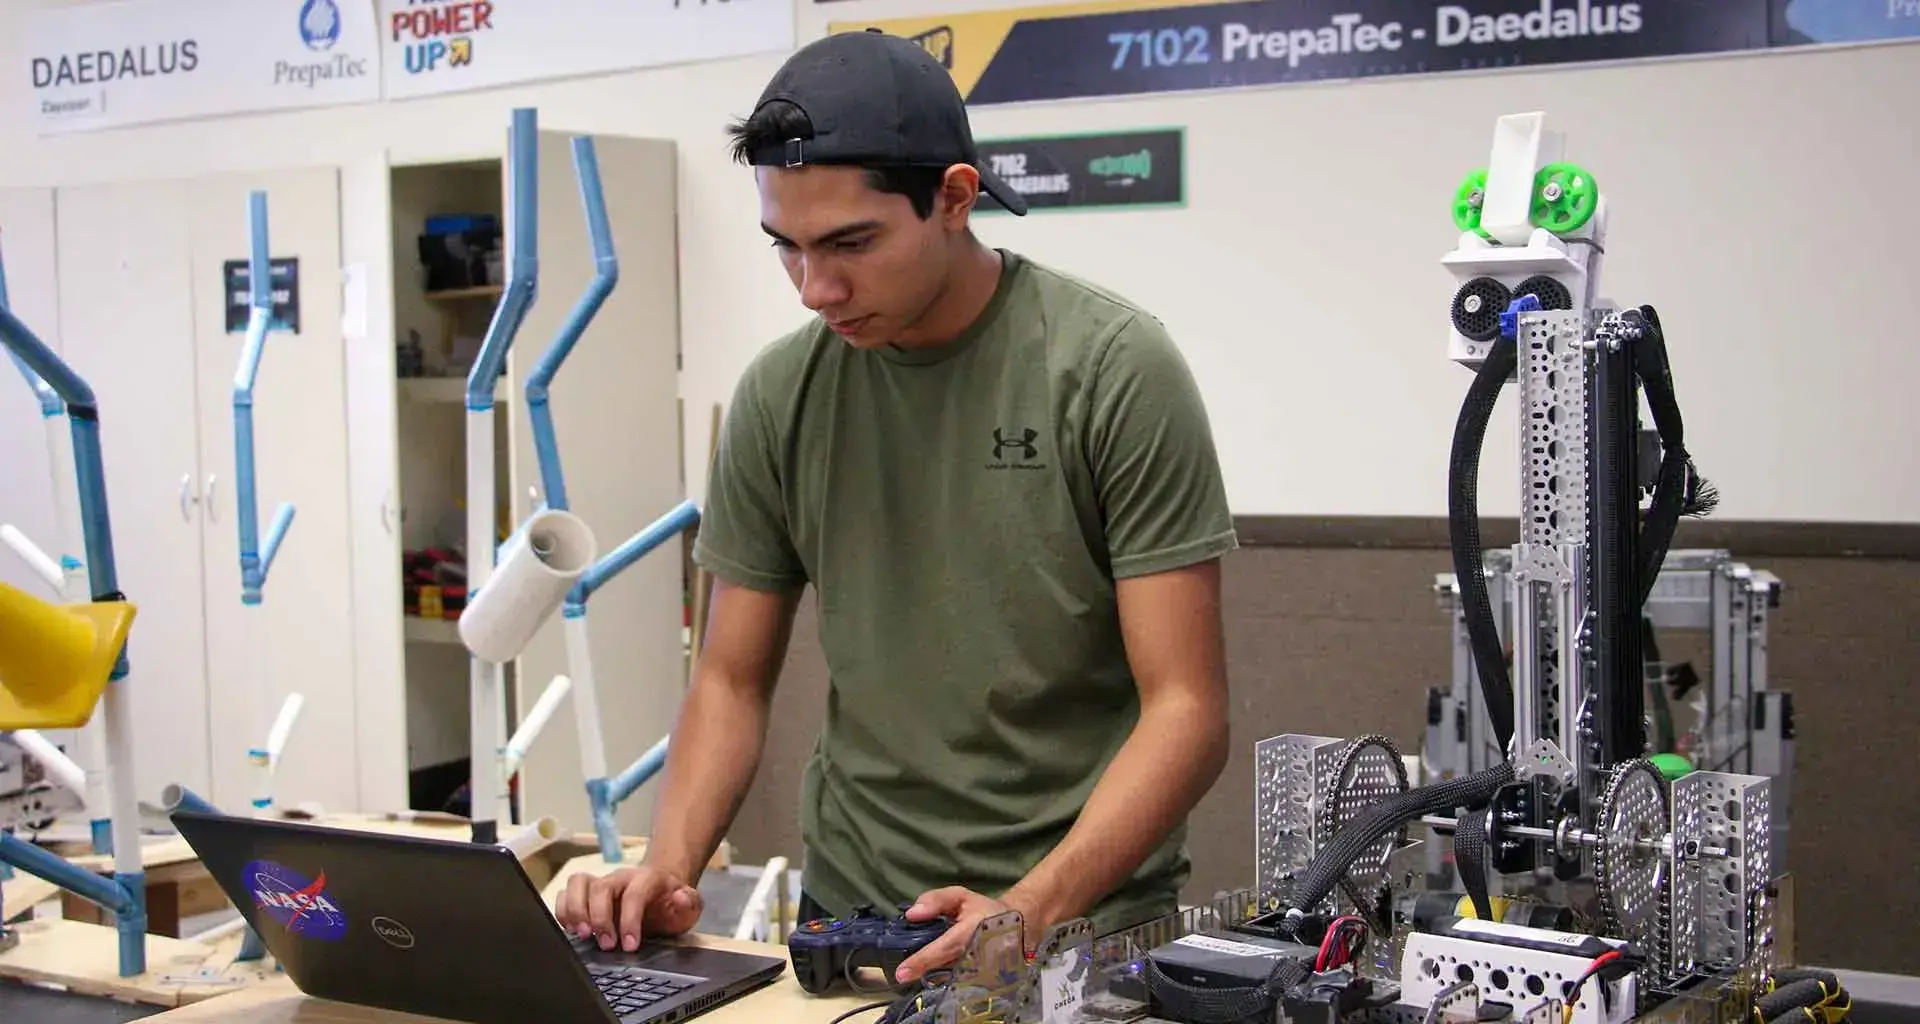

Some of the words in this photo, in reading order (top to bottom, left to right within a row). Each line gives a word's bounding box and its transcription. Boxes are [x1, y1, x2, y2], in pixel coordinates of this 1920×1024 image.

[391, 1, 493, 42] POWER
[1108, 26, 1209, 70] 7102
[1222, 14, 1402, 67] PrepaTec
[1411, 28, 1425, 39] -
[1436, 0, 1642, 46] Daedalus
[32, 39, 199, 89] DAEDALUS
[270, 53, 367, 89] PrepaTec
[404, 41, 446, 74] UP
[254, 889, 339, 919] NASA
